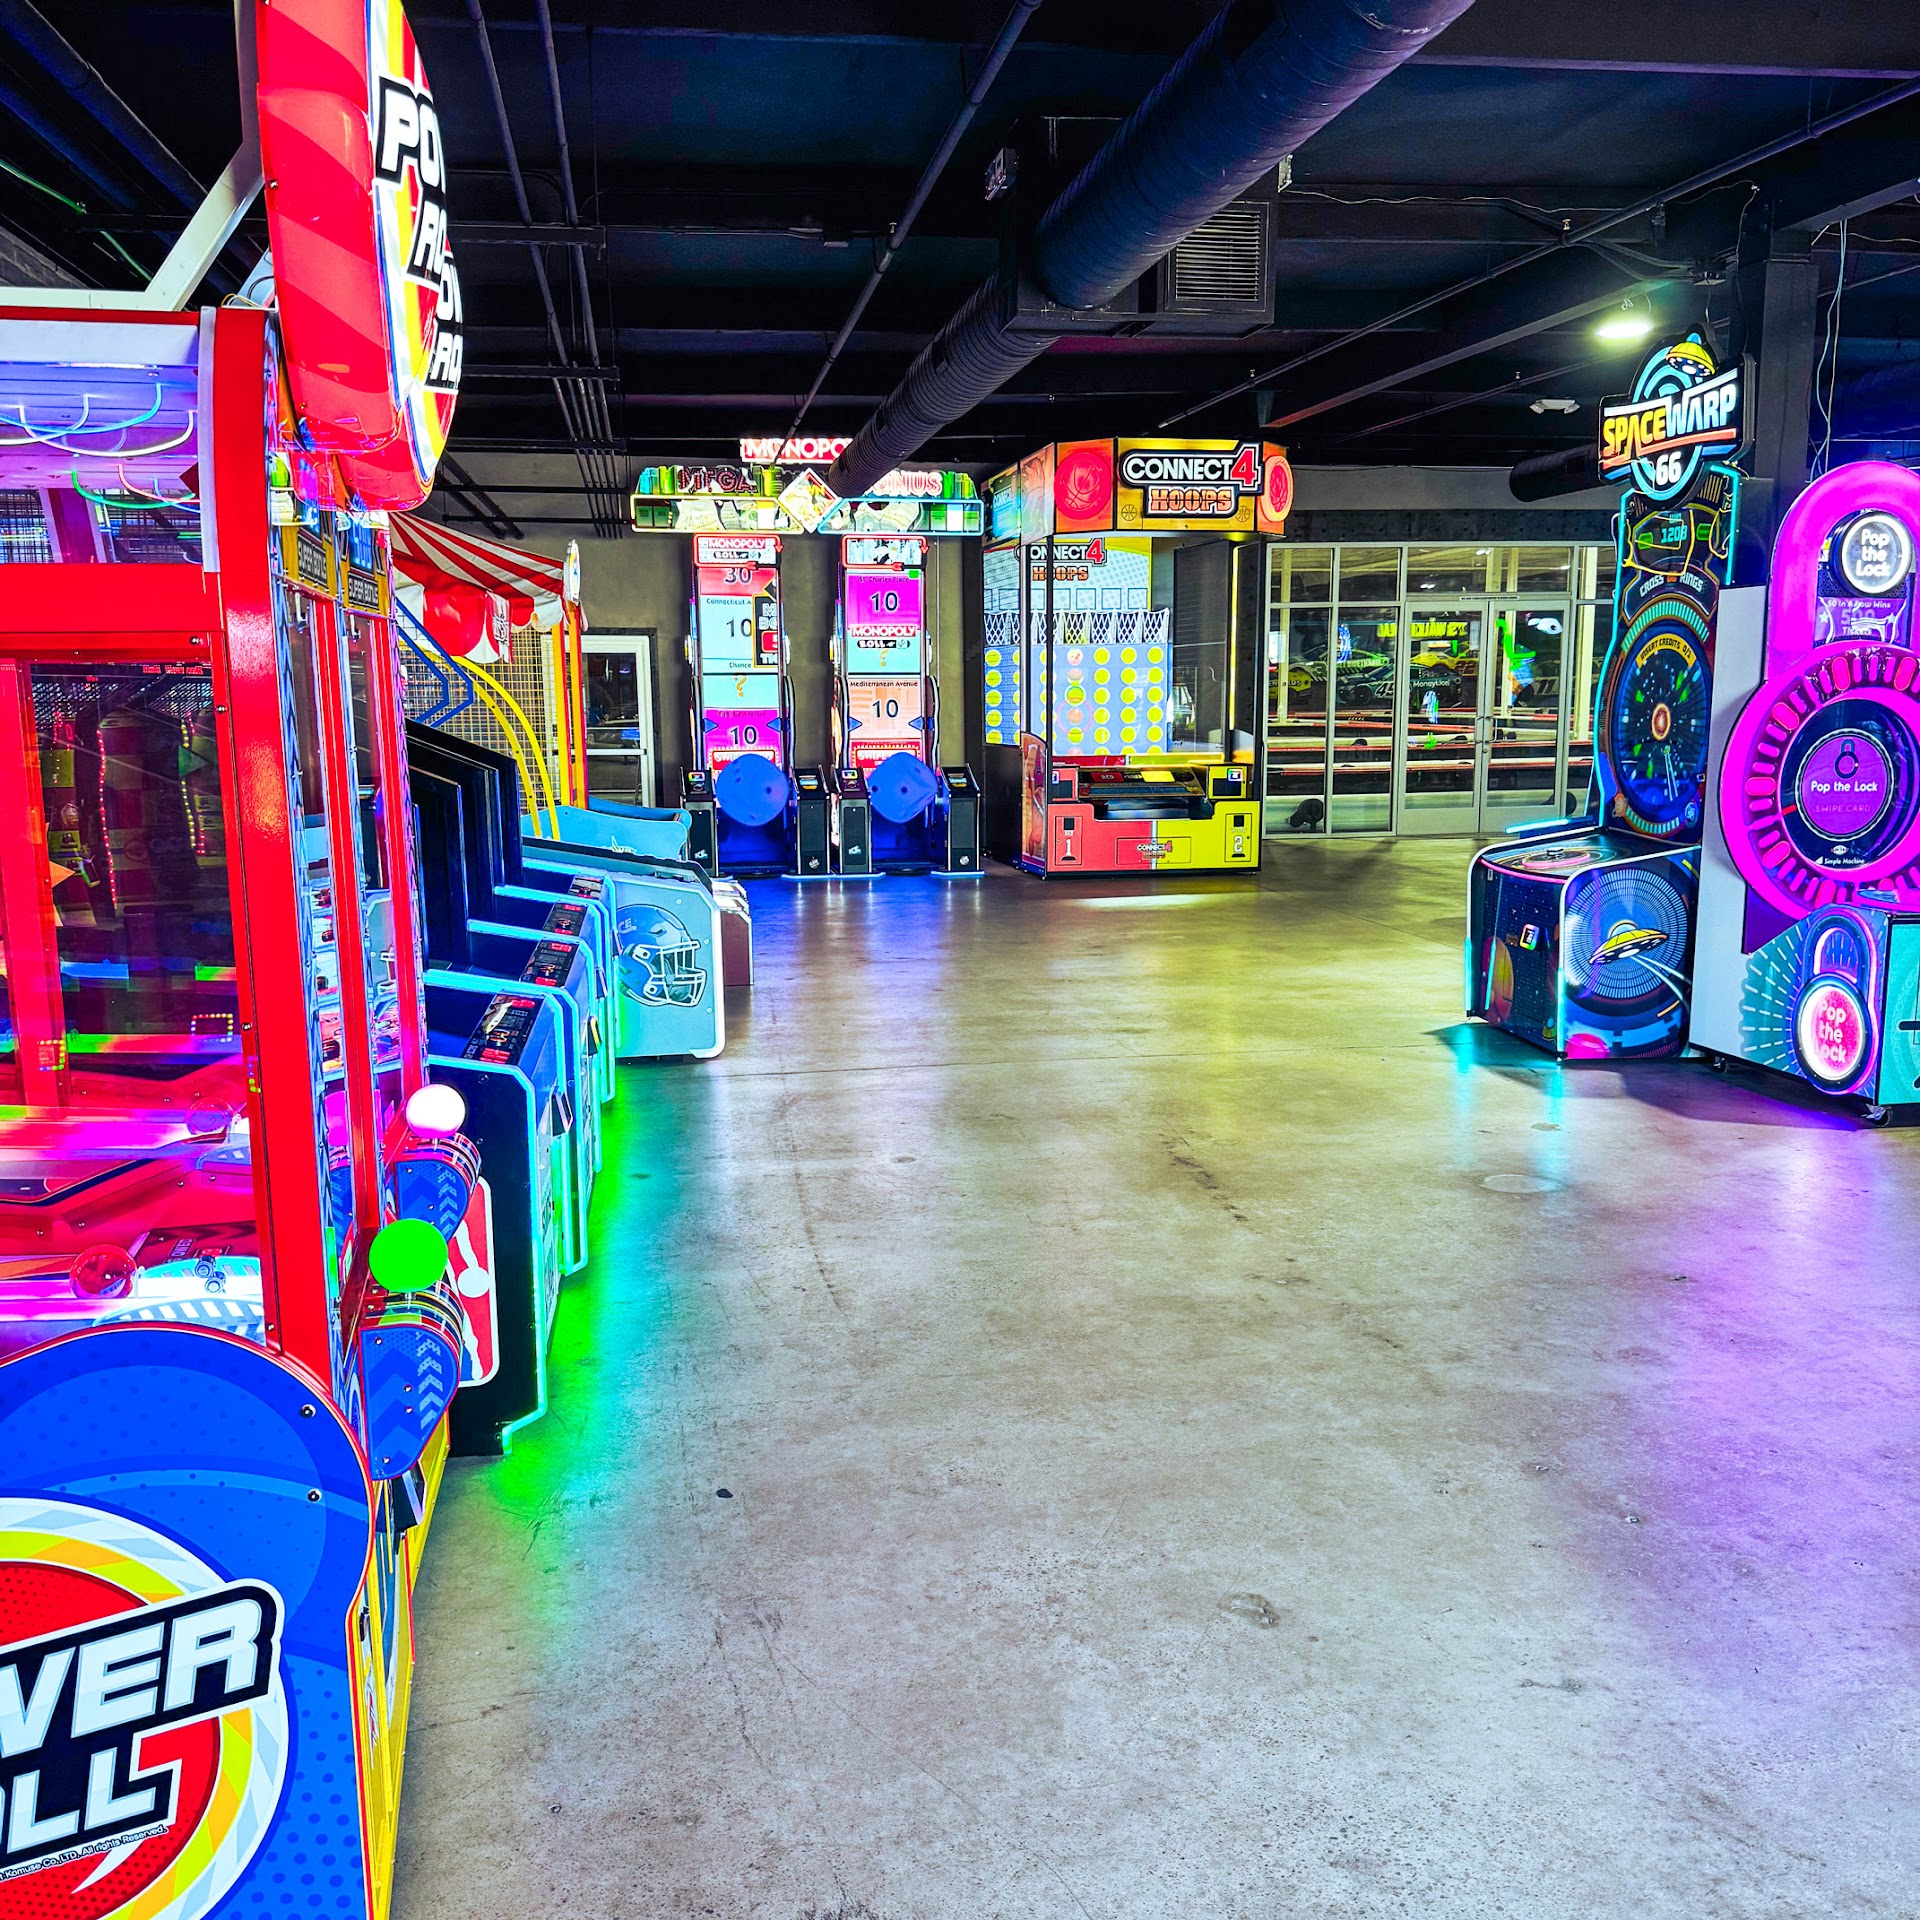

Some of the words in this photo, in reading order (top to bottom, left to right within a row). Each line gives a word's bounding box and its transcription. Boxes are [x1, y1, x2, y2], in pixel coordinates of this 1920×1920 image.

[1655, 451, 1681, 485] 66
[677, 467, 757, 493] MEGA
[869, 471, 943, 497] ONUS
[1150, 488, 1233, 512] HOOPS
[708, 539, 766, 549] MONOPOLY
[1862, 529, 1890, 549] Pop
[1862, 546, 1887, 561] the
[724, 567, 752, 584] 30
[1032, 566, 1088, 581] HOPS
[1856, 560, 1891, 576] Lock
[1639, 574, 1665, 598] CROSS
[1679, 572, 1704, 593] RINGS
[870, 591, 898, 612] 10
[726, 618, 752, 638] 10
[852, 626, 916, 637] MONOPOLY
[1659, 638, 1681, 649] CREDITS
[729, 661, 752, 669] Chance
[1413, 679, 1450, 688] MoneyLion
[872, 699, 899, 718] 10
[730, 726, 757, 745] 10
[1811, 781, 1830, 794] Pop
[1834, 781, 1850, 792] the
[1854, 781, 1877, 792] Lock
[1815, 804, 1844, 812] SWIPE
[1846, 804, 1871, 812] CARD
[1065, 838, 1072, 857] 1
[1233, 835, 1243, 853] 2
[1825, 858, 1841, 866] Simple
[1820, 999, 1847, 1026] Pop
[1819, 1021, 1844, 1043] the
[0, 1747, 157, 1853] LL
[5, 1864, 42, 1878] Komuse
[83, 1845, 94, 1856] All
[96, 1839, 121, 1853] rights
[123, 1826, 168, 1844] Reserved.
